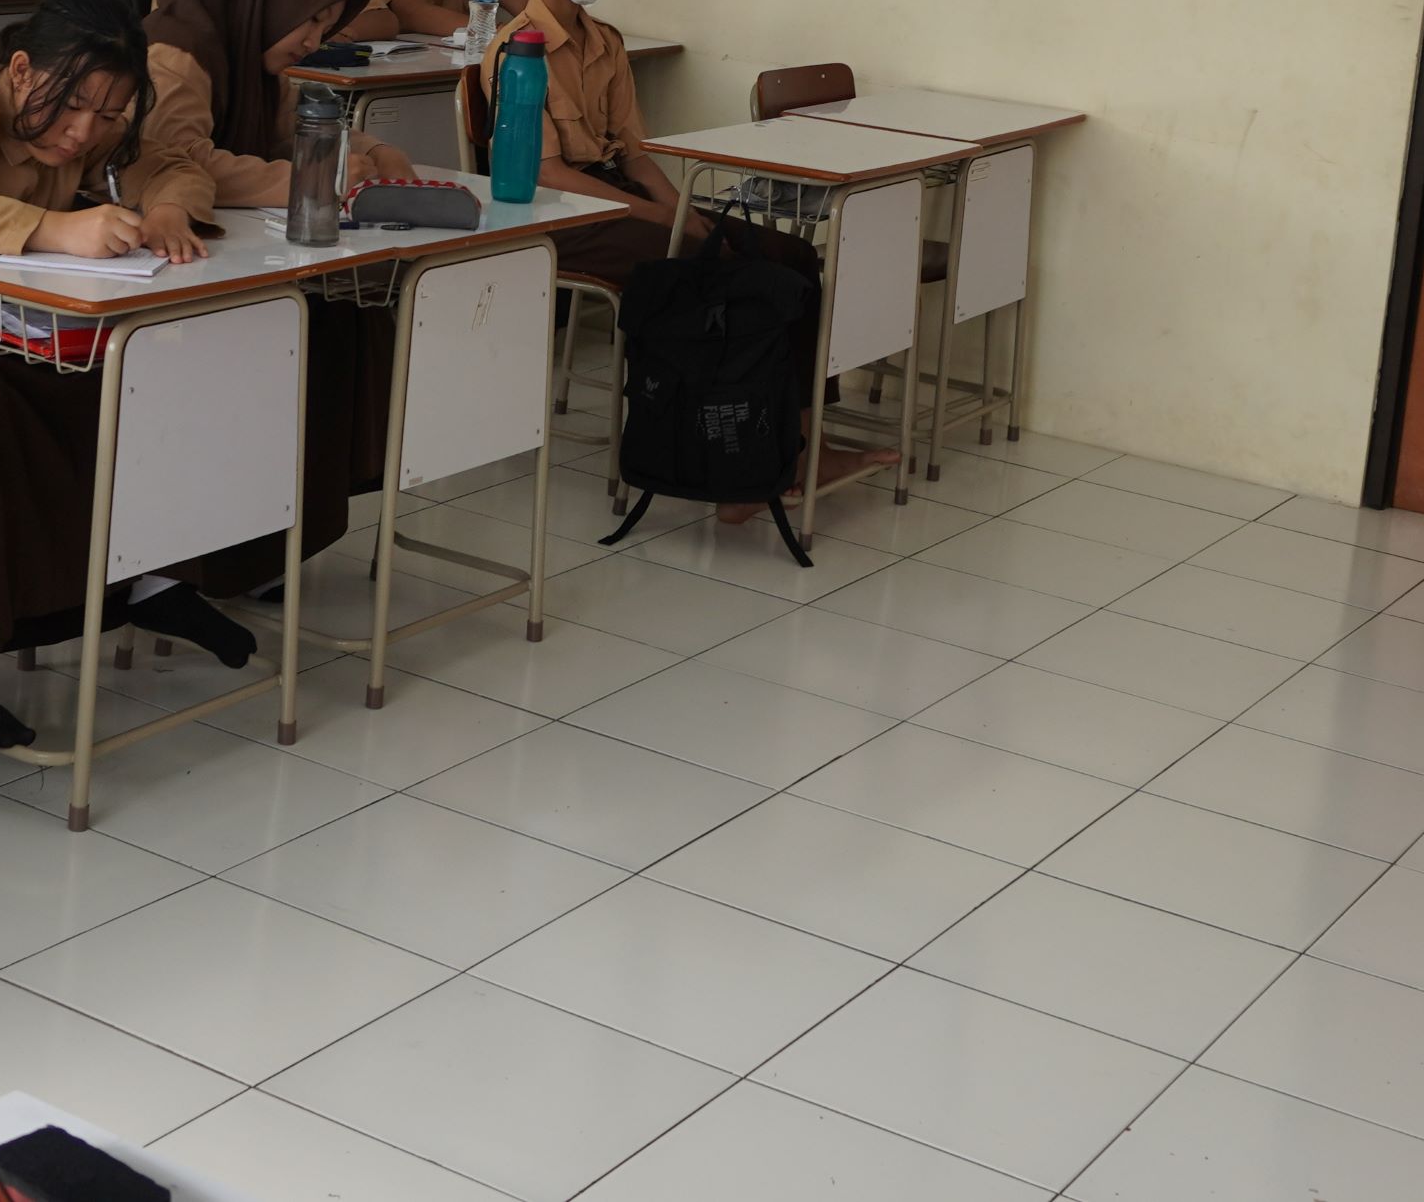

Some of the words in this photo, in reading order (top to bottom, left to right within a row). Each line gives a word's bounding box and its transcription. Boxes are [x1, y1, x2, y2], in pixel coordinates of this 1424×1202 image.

[703, 405, 721, 440] FORCE
[720, 404, 740, 454] ULTIMATE
[735, 401, 750, 422] THE
